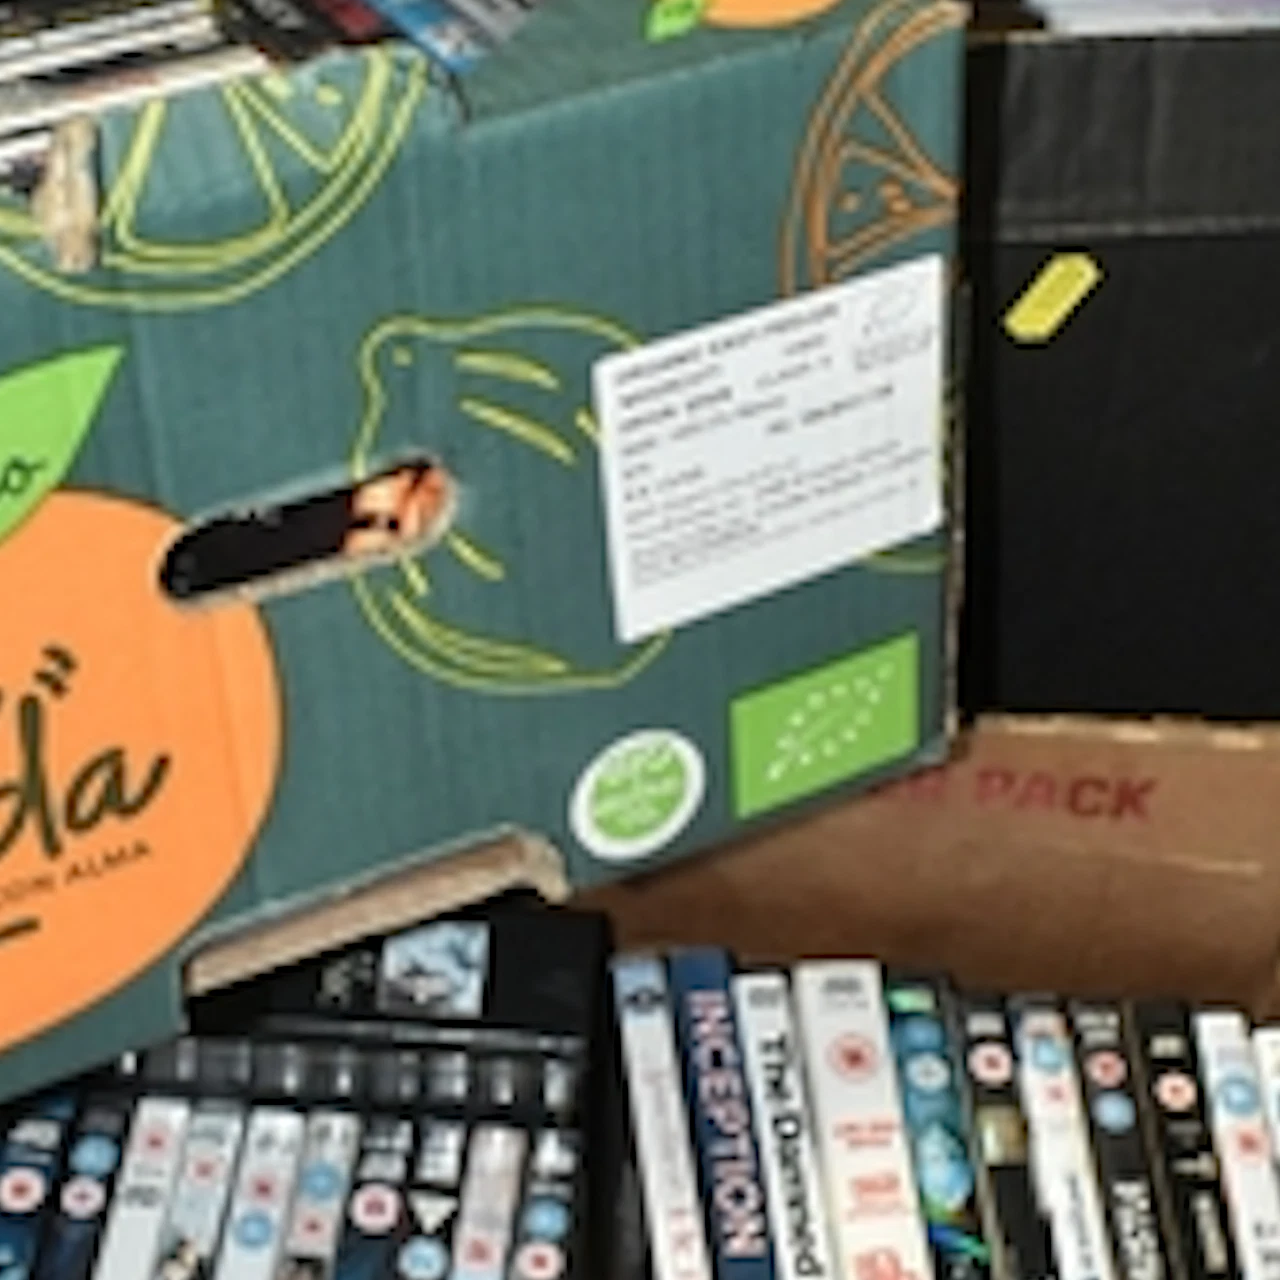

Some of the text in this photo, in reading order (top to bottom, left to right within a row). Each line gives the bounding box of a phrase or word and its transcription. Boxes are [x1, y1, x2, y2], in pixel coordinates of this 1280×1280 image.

[975, 770, 1157, 821] PACK
[65, 841, 151, 885] ALMA
[759, 1034, 792, 1099] The
[686, 988, 765, 1259] INCEPTION
[773, 1114, 826, 1276] Damned
